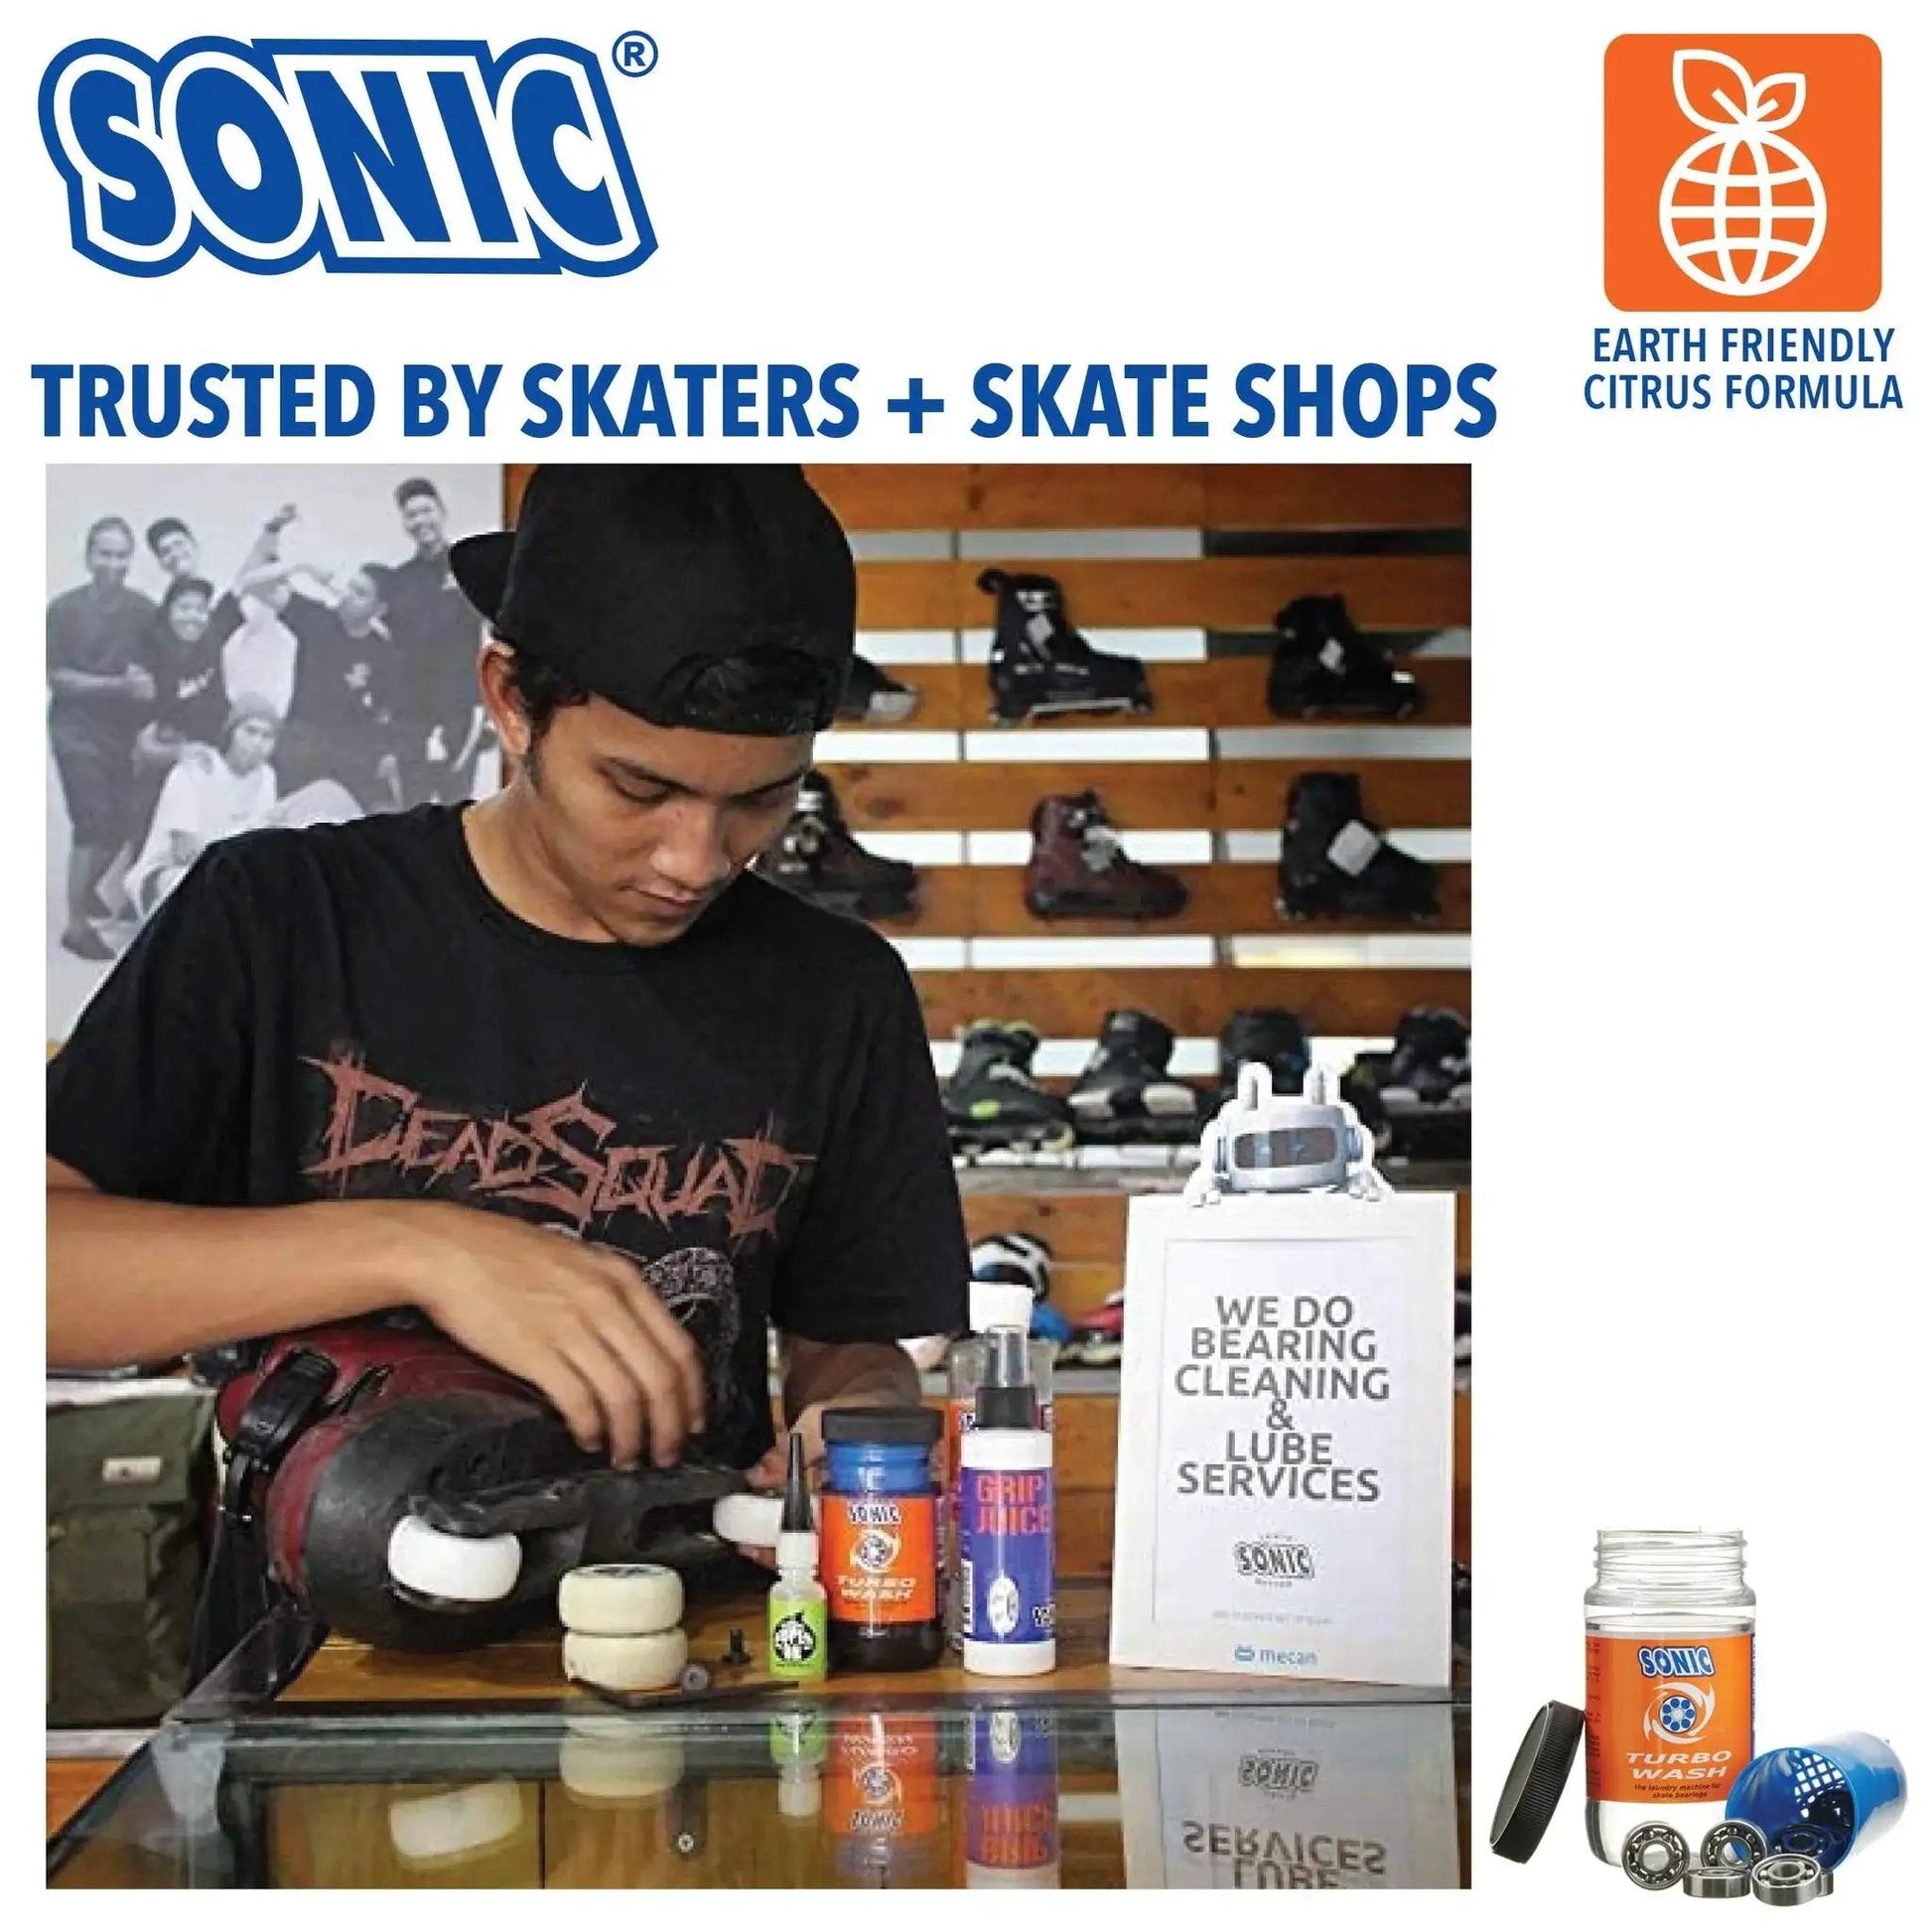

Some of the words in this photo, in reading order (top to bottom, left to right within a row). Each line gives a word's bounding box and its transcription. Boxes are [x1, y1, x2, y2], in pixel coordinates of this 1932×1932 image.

[1215, 1296, 1279, 1327] WE
[1294, 1296, 1354, 1327] DO
[1191, 1326, 1377, 1362] BEARING
[1174, 1363, 1390, 1400] CLEANING
[1266, 1398, 1295, 1431] &
[1226, 1430, 1332, 1465] LUBE
[977, 1474, 1041, 1502] GRIP
[1177, 1461, 1381, 1502] SERVICES
[1234, 1542, 1314, 1581] SONIC
[1639, 1647, 1715, 1677] SONIC
[1626, 1750, 1731, 1764] TURBO
[1632, 1766, 1726, 1780] WASH
